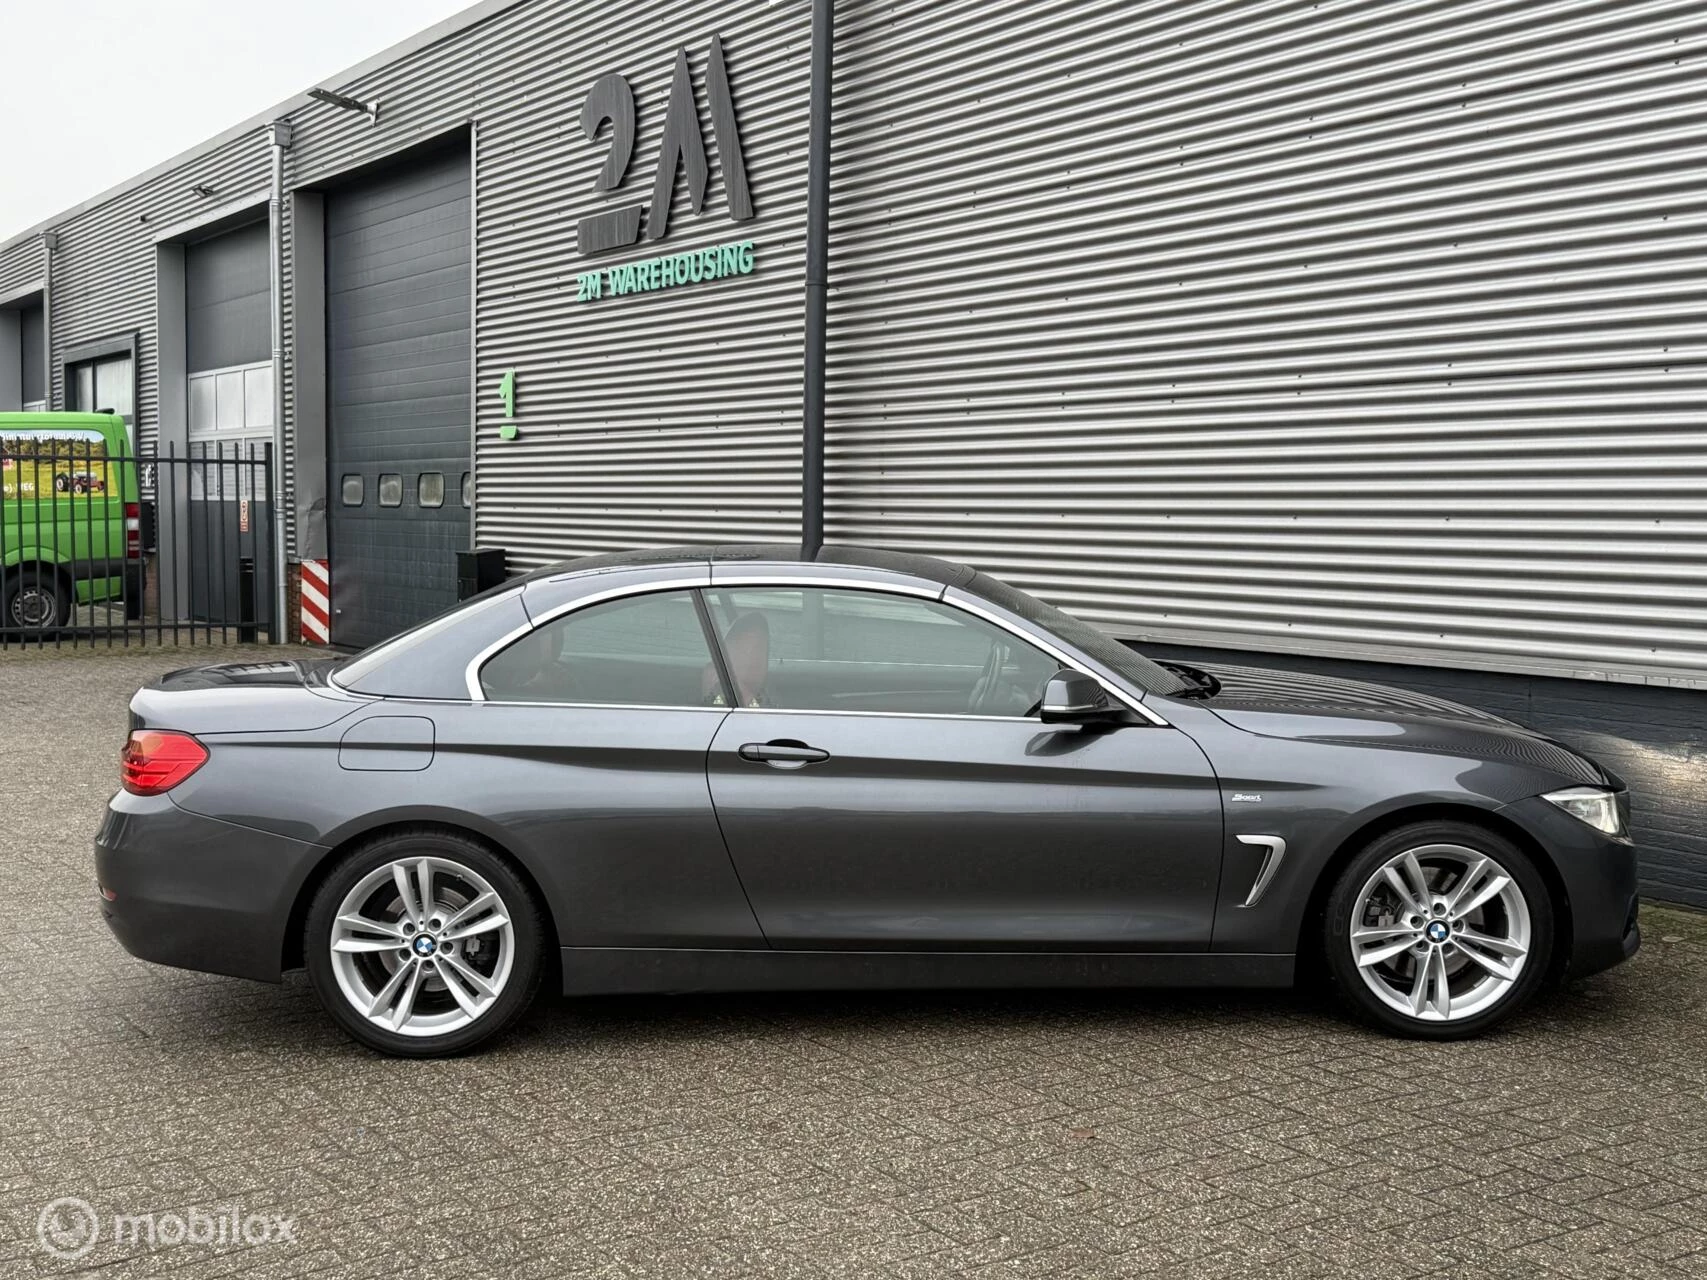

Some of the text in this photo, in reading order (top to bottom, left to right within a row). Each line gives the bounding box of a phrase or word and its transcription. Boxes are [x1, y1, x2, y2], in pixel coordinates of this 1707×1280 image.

[577, 33, 755, 254] 2M
[577, 240, 754, 301] 2M WAREHOUSING
